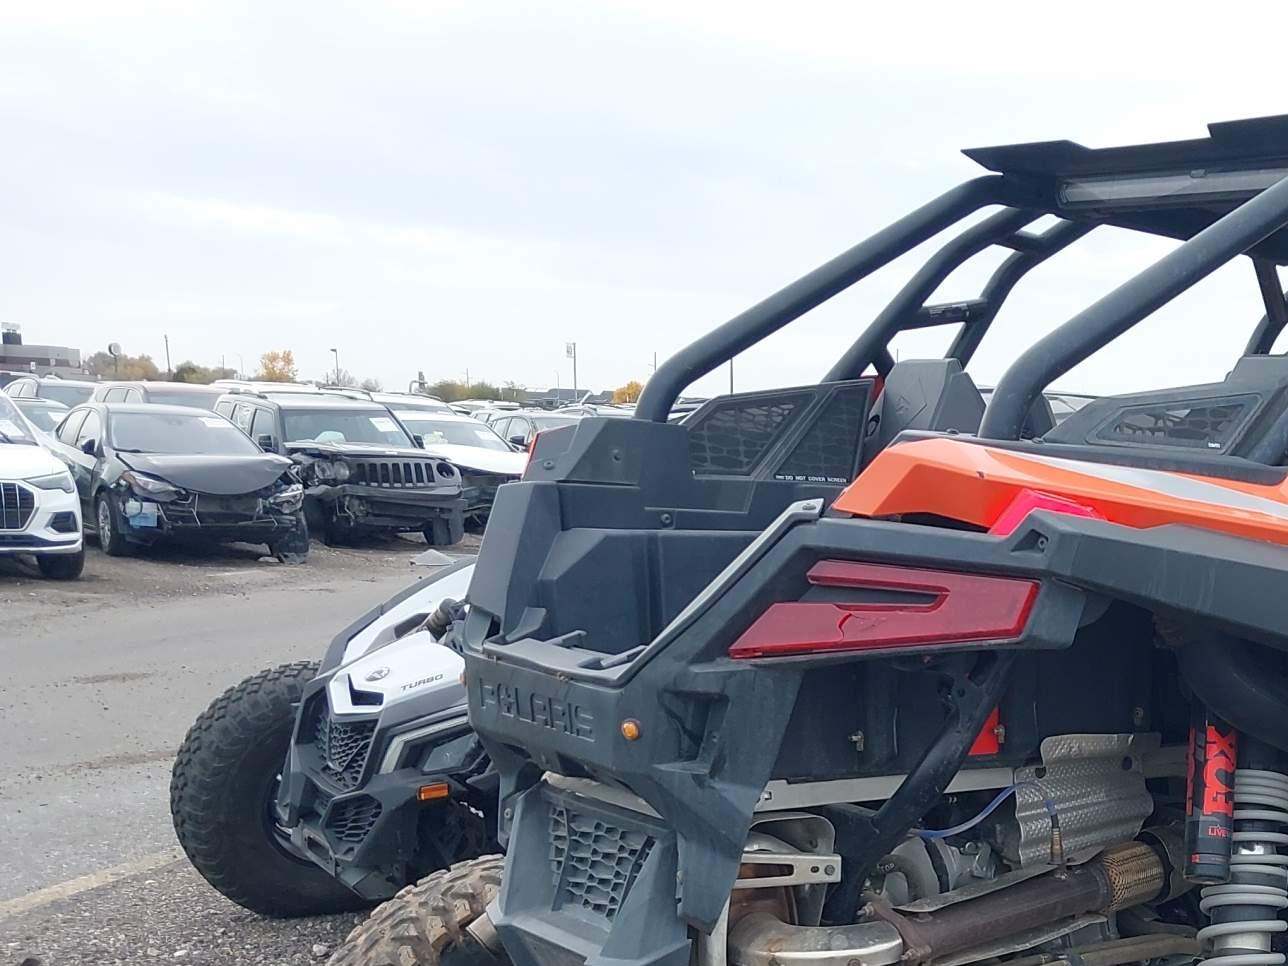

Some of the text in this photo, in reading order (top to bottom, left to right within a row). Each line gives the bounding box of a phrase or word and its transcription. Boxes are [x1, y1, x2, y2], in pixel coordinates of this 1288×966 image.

[400, 673, 444, 692] TURBO
[479, 678, 596, 743] POLARIS
[1202, 725, 1239, 817] FOX
